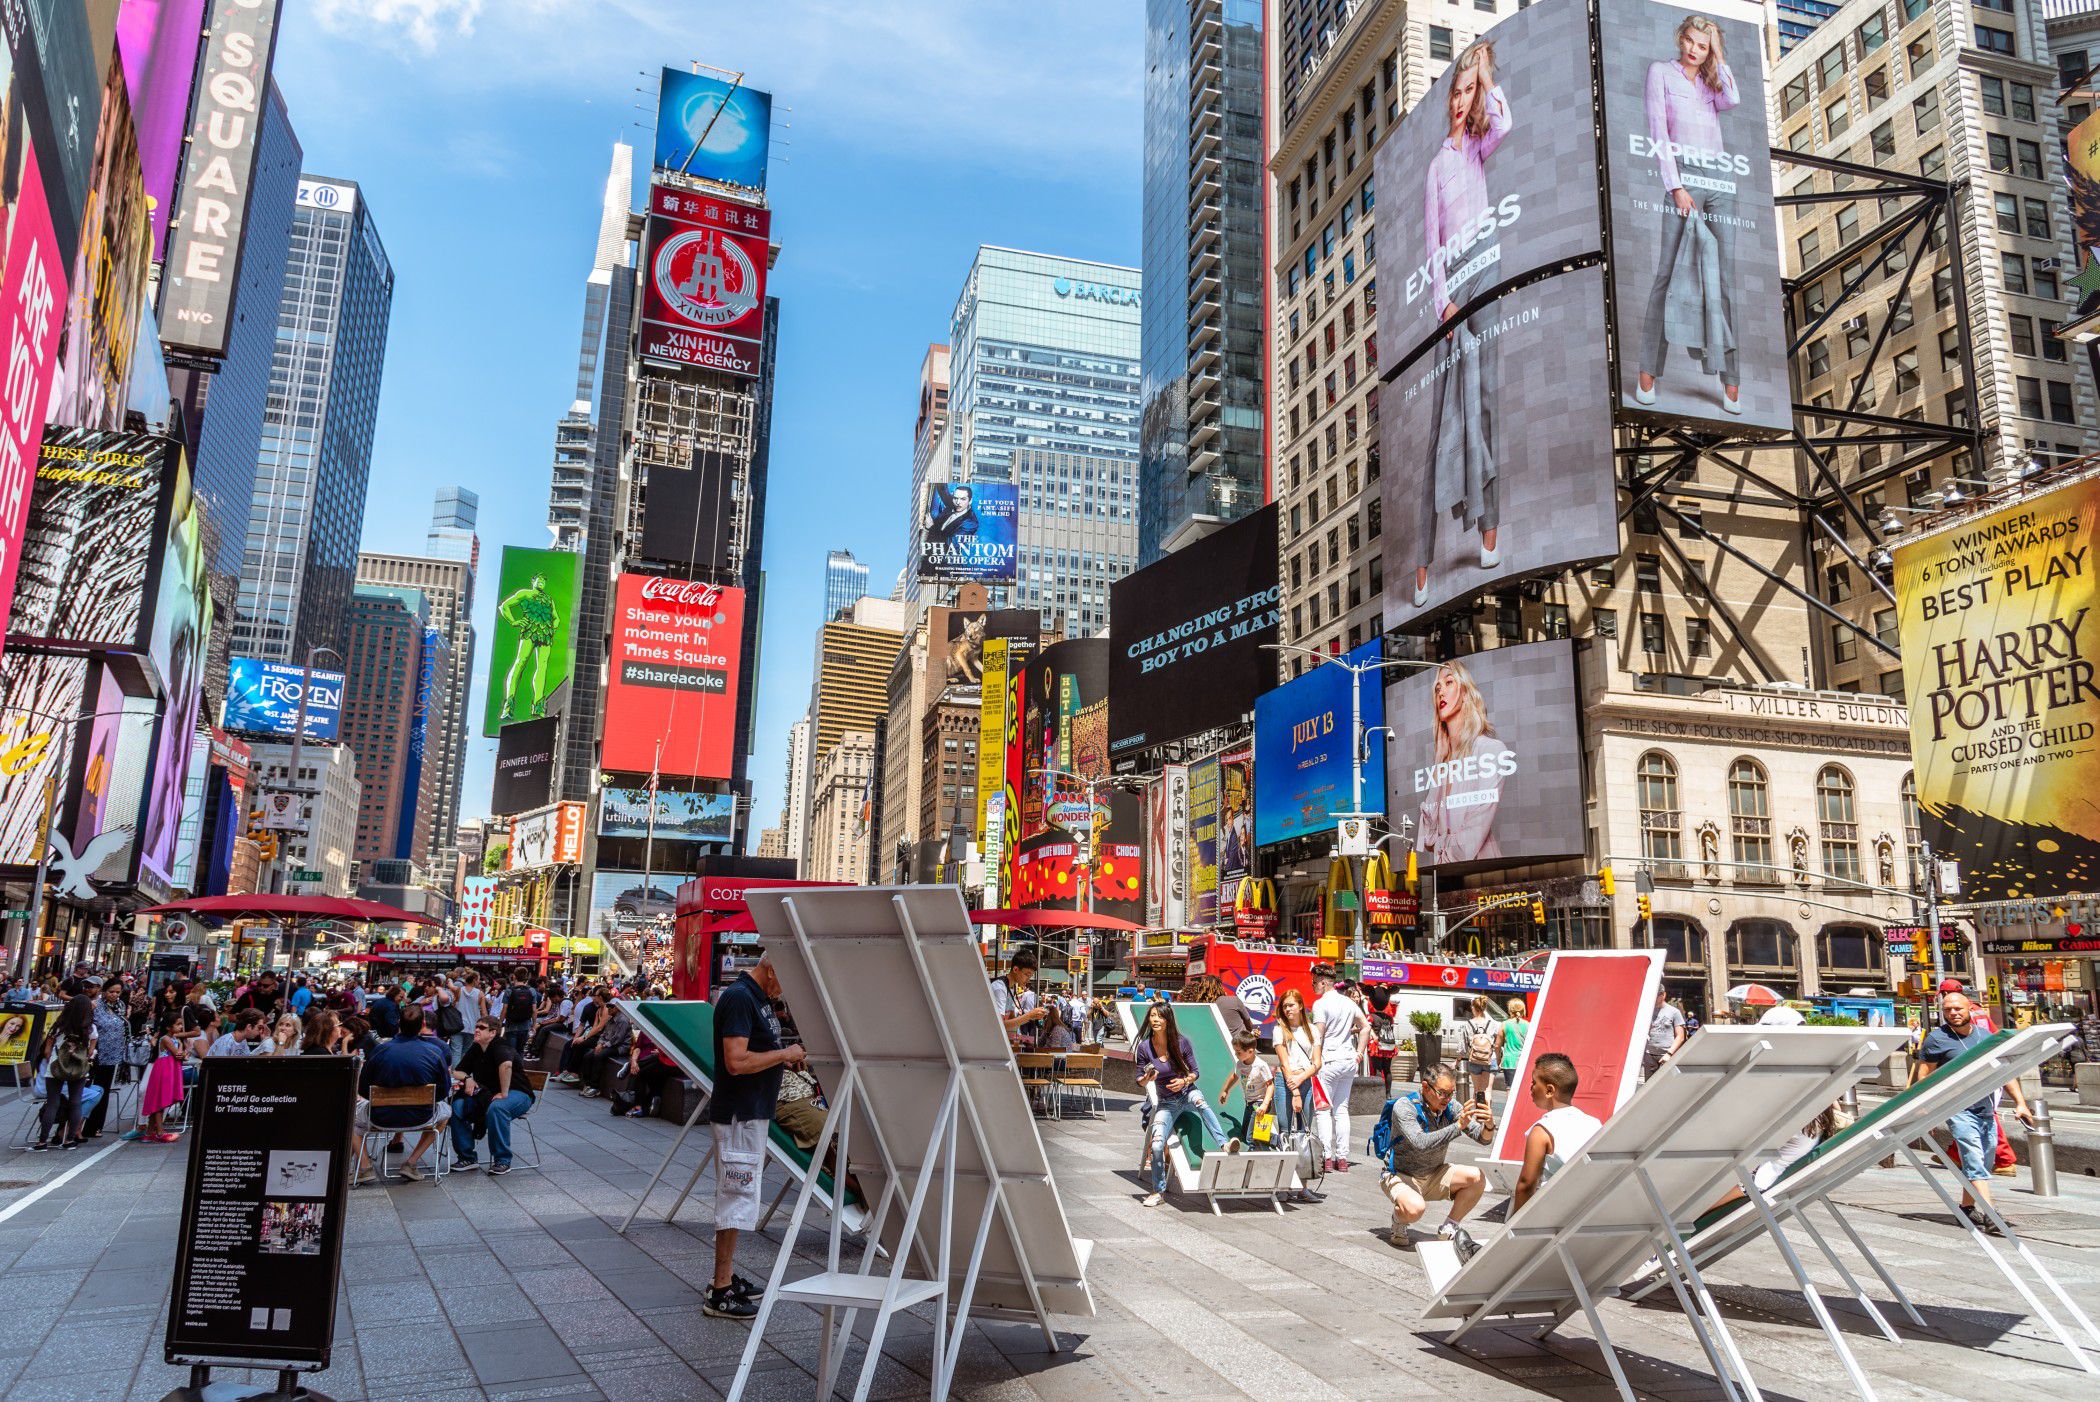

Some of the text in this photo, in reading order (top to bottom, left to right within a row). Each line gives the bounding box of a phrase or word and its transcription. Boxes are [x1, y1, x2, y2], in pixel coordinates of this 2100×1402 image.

[184, 32, 256, 282] SQUARE
[1629, 133, 1750, 176] EXPRESS
[1683, 176, 1734, 192] MADISON
[663, 195, 760, 229] 新华通讯社
[1633, 200, 1756, 229] THE WORKWEAR DESTINATION
[1406, 193, 1522, 306] EXPRESS
[1446, 250, 1498, 292] MADISON
[18, 236, 53, 367] ARE
[676, 300, 737, 323] XINHUA
[177, 309, 213, 325] NYC
[650, 342, 751, 372] NEWS AGENCY
[666, 331, 737, 358] XINHUA
[1404, 306, 1540, 403] THE WORKWEAR DESTINATION
[4, 313, 39, 445] YOU
[92, 451, 146, 469] GIRLS!
[956, 535, 979, 543] THE
[1952, 511, 2036, 551] WINNER!
[920, 542, 1015, 558] PHANTOM
[928, 556, 1006, 566] OF THE OPERA
[1922, 516, 2079, 581] 6 TONY AWARDS
[1980, 557, 2016, 574] including
[641, 576, 717, 606] Coca-Cola
[1921, 546, 2088, 621] BEST PLAY
[626, 608, 710, 629] Share your
[1127, 584, 1280, 659] CHANGING FRO
[625, 626, 689, 645] moment
[624, 644, 727, 666] Times Square
[1141, 645, 1178, 674] BOY
[1180, 636, 1210, 659] TO
[1210, 631, 1228, 648] A
[1932, 607, 2091, 691] HARRY
[271, 665, 304, 676] SERIOUS
[311, 670, 345, 681] EGAHIT!
[413, 645, 436, 717] NOVOTEL
[625, 666, 724, 688] #shareacoke
[1061, 677, 1071, 711] HOT
[1927, 660, 2100, 741] POTTER
[305, 715, 329, 724] HEATRE
[1730, 695, 1909, 728] I MILLER BUILDIN
[1292, 711, 1334, 754] JULY 13
[1622, 719, 1897, 751] THE SHOW FOLKS SHOE SHOP DEDICATED TO
[1991, 719, 2041, 738] AND THE
[1061, 718, 1070, 766] FUSS
[1112, 735, 1145, 750] SCORPION
[1951, 722, 2094, 764] CURSED CHILD
[500, 753, 549, 769] JENNIFER LOPEZ
[1414, 750, 1518, 793] EXPRESS
[1970, 749, 2074, 775] PARTS ONE AND TWO
[606, 802, 666, 814] The smrt
[1448, 793, 1496, 806] MADISON
[606, 813, 684, 826] utility vhicle.
[562, 806, 581, 861] HELLO!
[1172, 777, 1184, 901] PALACE
[986, 820, 999, 888] EXPERIENCE
[1369, 895, 1417, 906] McDonald's
[1478, 892, 1528, 910] EXPRESS
[1237, 912, 1278, 921] McDonald's
[1982, 903, 2051, 927] GIFTS
[2022, 942, 2053, 951] Nikon
[724, 958, 732, 967] A
[1485, 970, 1543, 986] TOPVIEW
[1988, 978, 1998, 1002] ATM
[217, 1095, 297, 1104] The April Go collection
[218, 1085, 247, 1093] VESTRE
[215, 1105, 274, 1114] for Times Square
